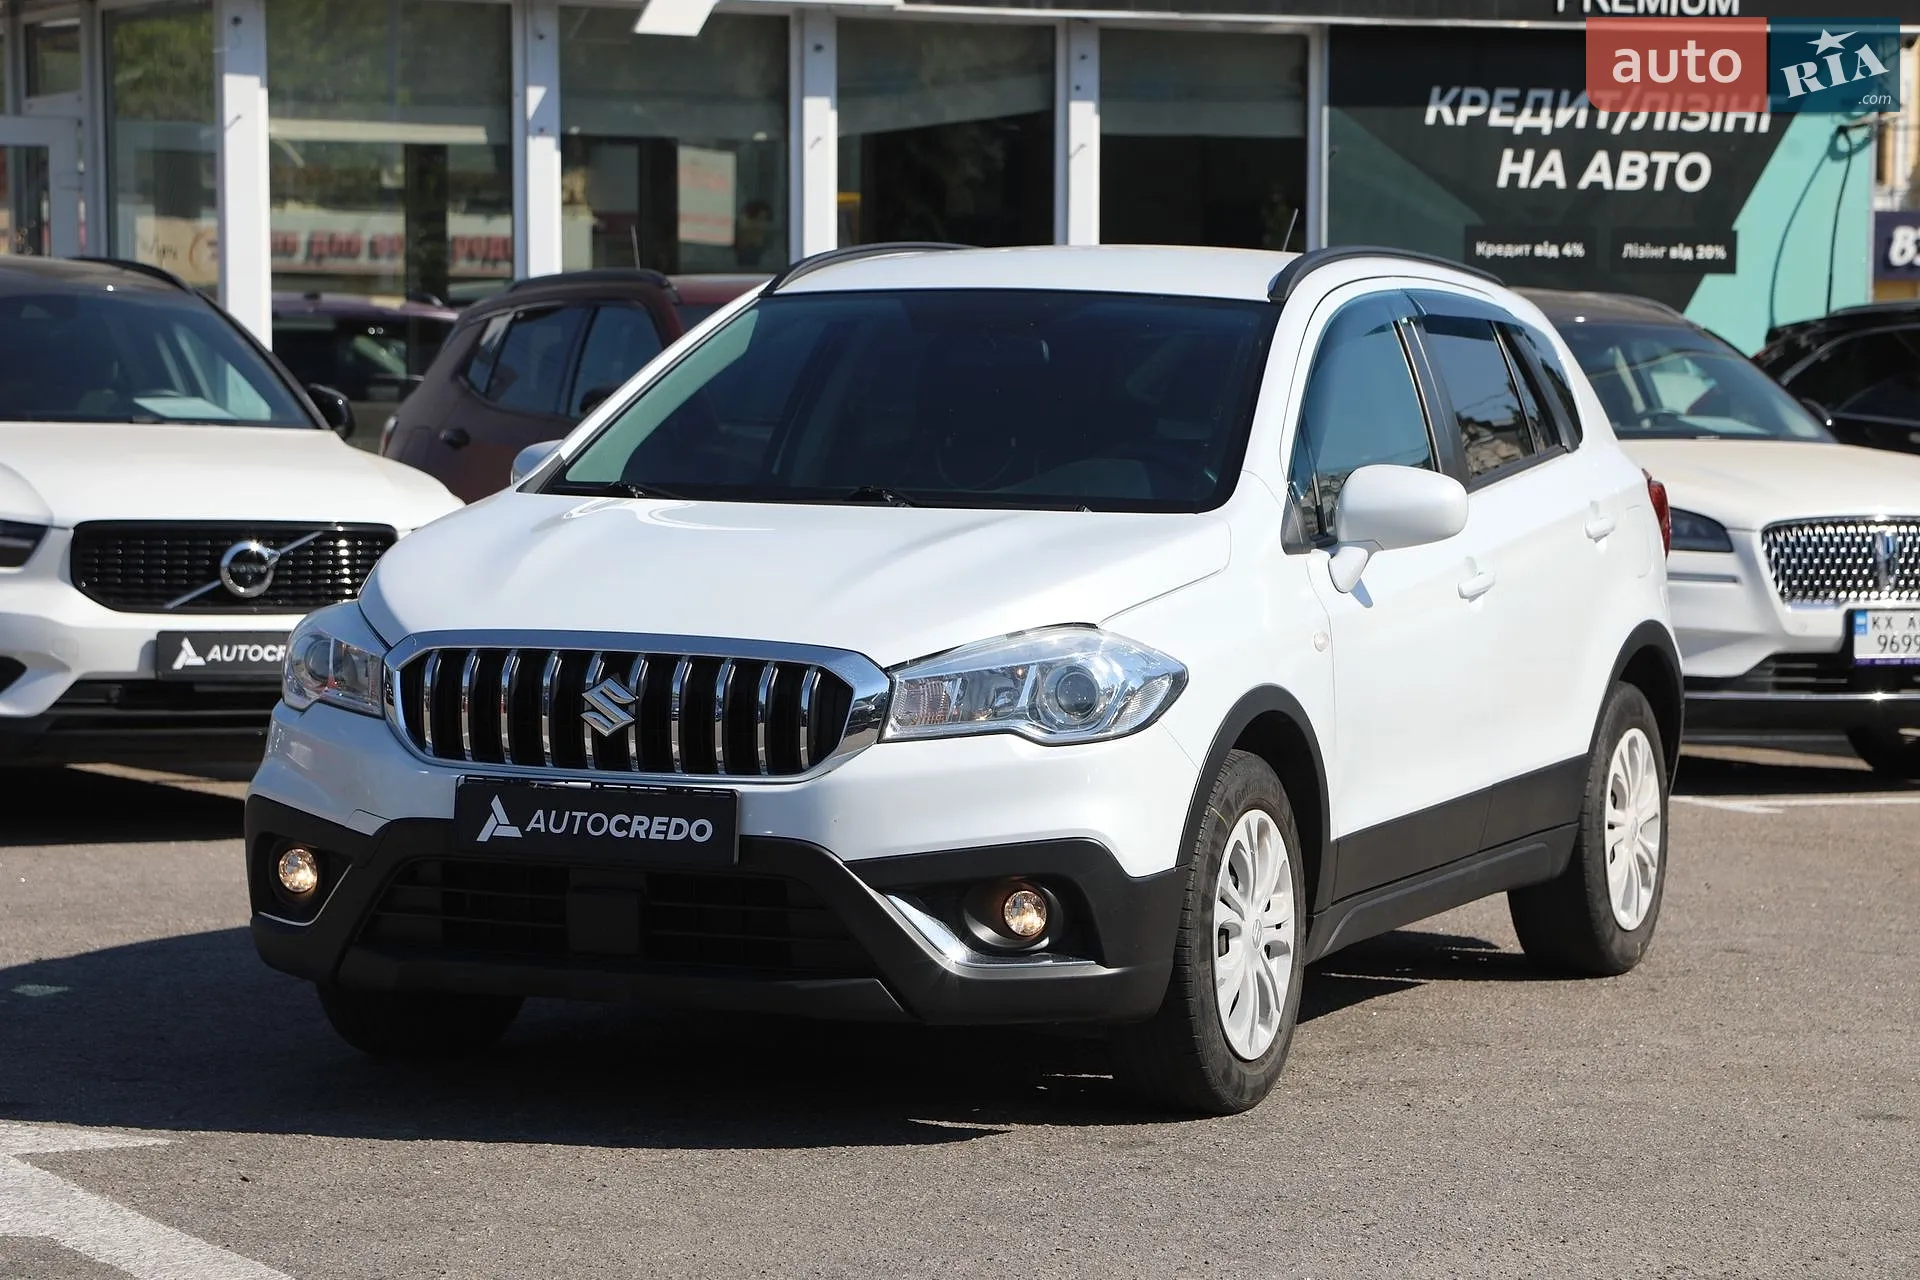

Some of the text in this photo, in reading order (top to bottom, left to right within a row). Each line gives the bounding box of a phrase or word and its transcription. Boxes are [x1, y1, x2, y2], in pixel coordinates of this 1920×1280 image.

[1496, 148, 1712, 192] НА АВТО
[1475, 240, 1586, 259] Кредит від 4%
[1669, 242, 1694, 261] від
[525, 809, 713, 843] AUTOCREDO
